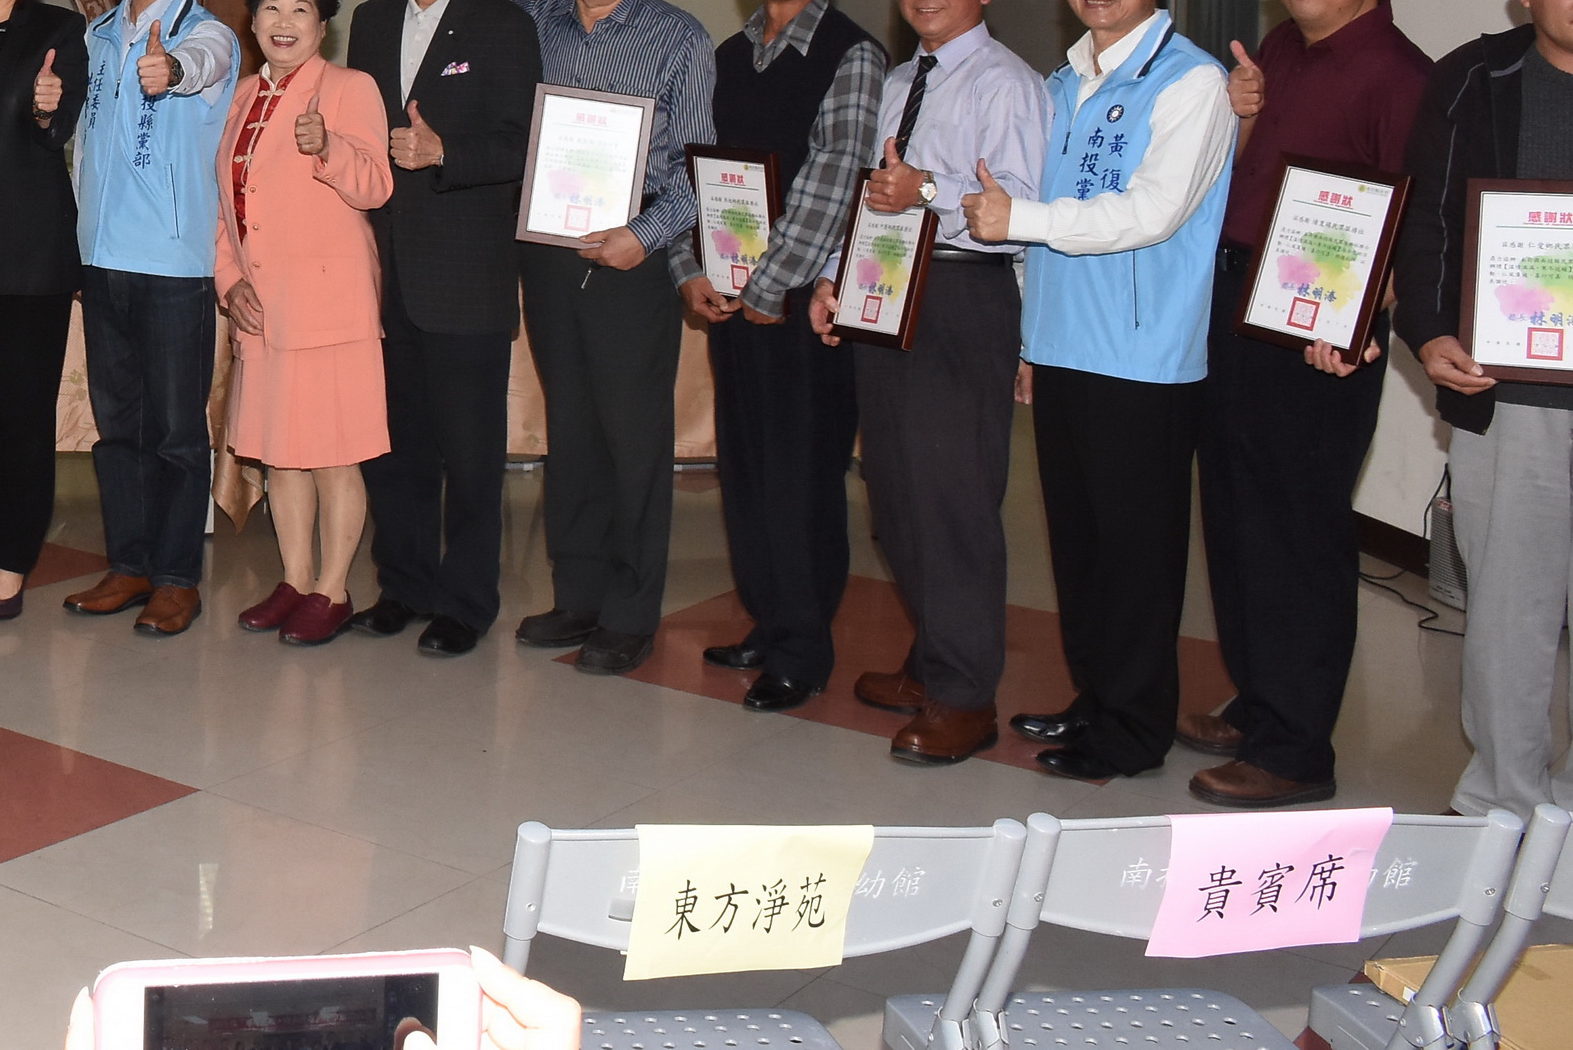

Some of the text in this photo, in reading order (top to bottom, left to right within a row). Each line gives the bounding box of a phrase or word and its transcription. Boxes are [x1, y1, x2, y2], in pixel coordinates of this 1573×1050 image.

[88, 60, 106, 129] 主任委員
[1317, 190, 1354, 207] 感謝狀
[1528, 211, 1573, 224] 感謝狀
[664, 872, 828, 941] 東方淨苑
[1196, 854, 1345, 922] 貴賓席
